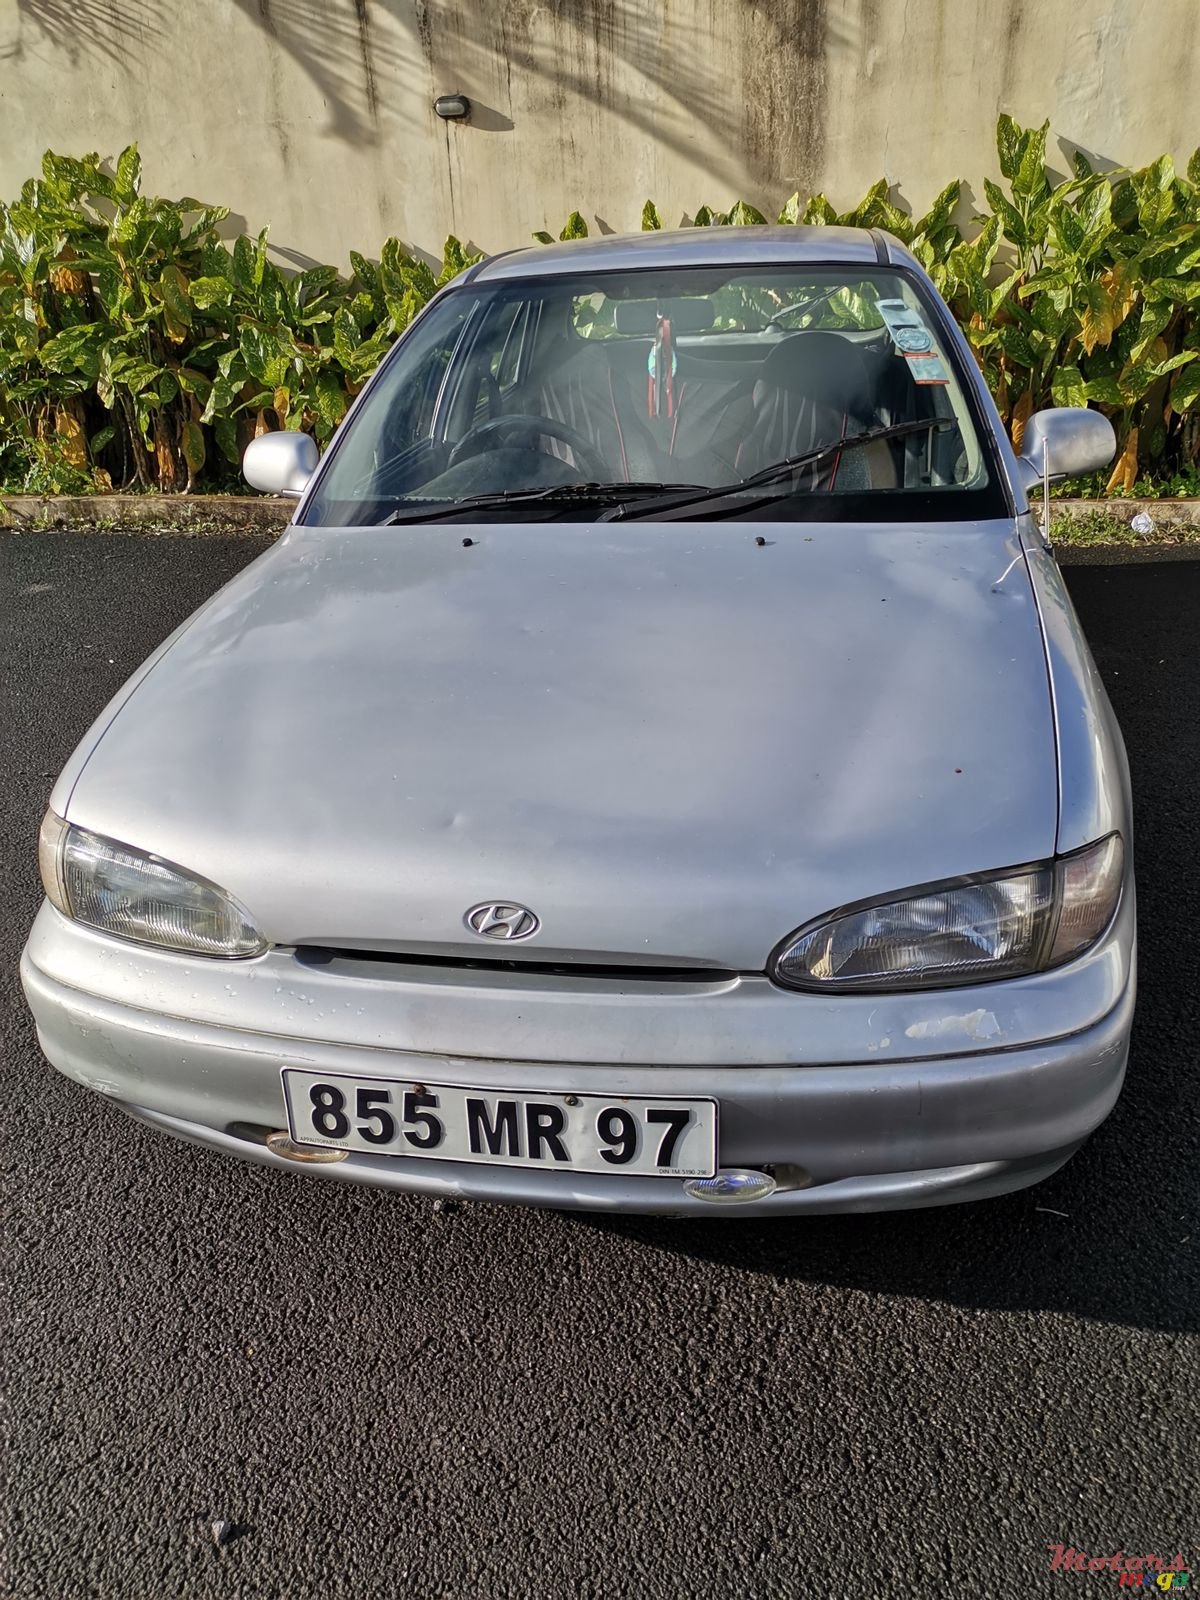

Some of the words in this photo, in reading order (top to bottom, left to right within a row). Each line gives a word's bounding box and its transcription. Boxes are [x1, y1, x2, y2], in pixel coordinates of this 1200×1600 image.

[309, 1083, 442, 1149] 855
[466, 1098, 570, 1161] MR
[597, 1107, 690, 1168] 97
